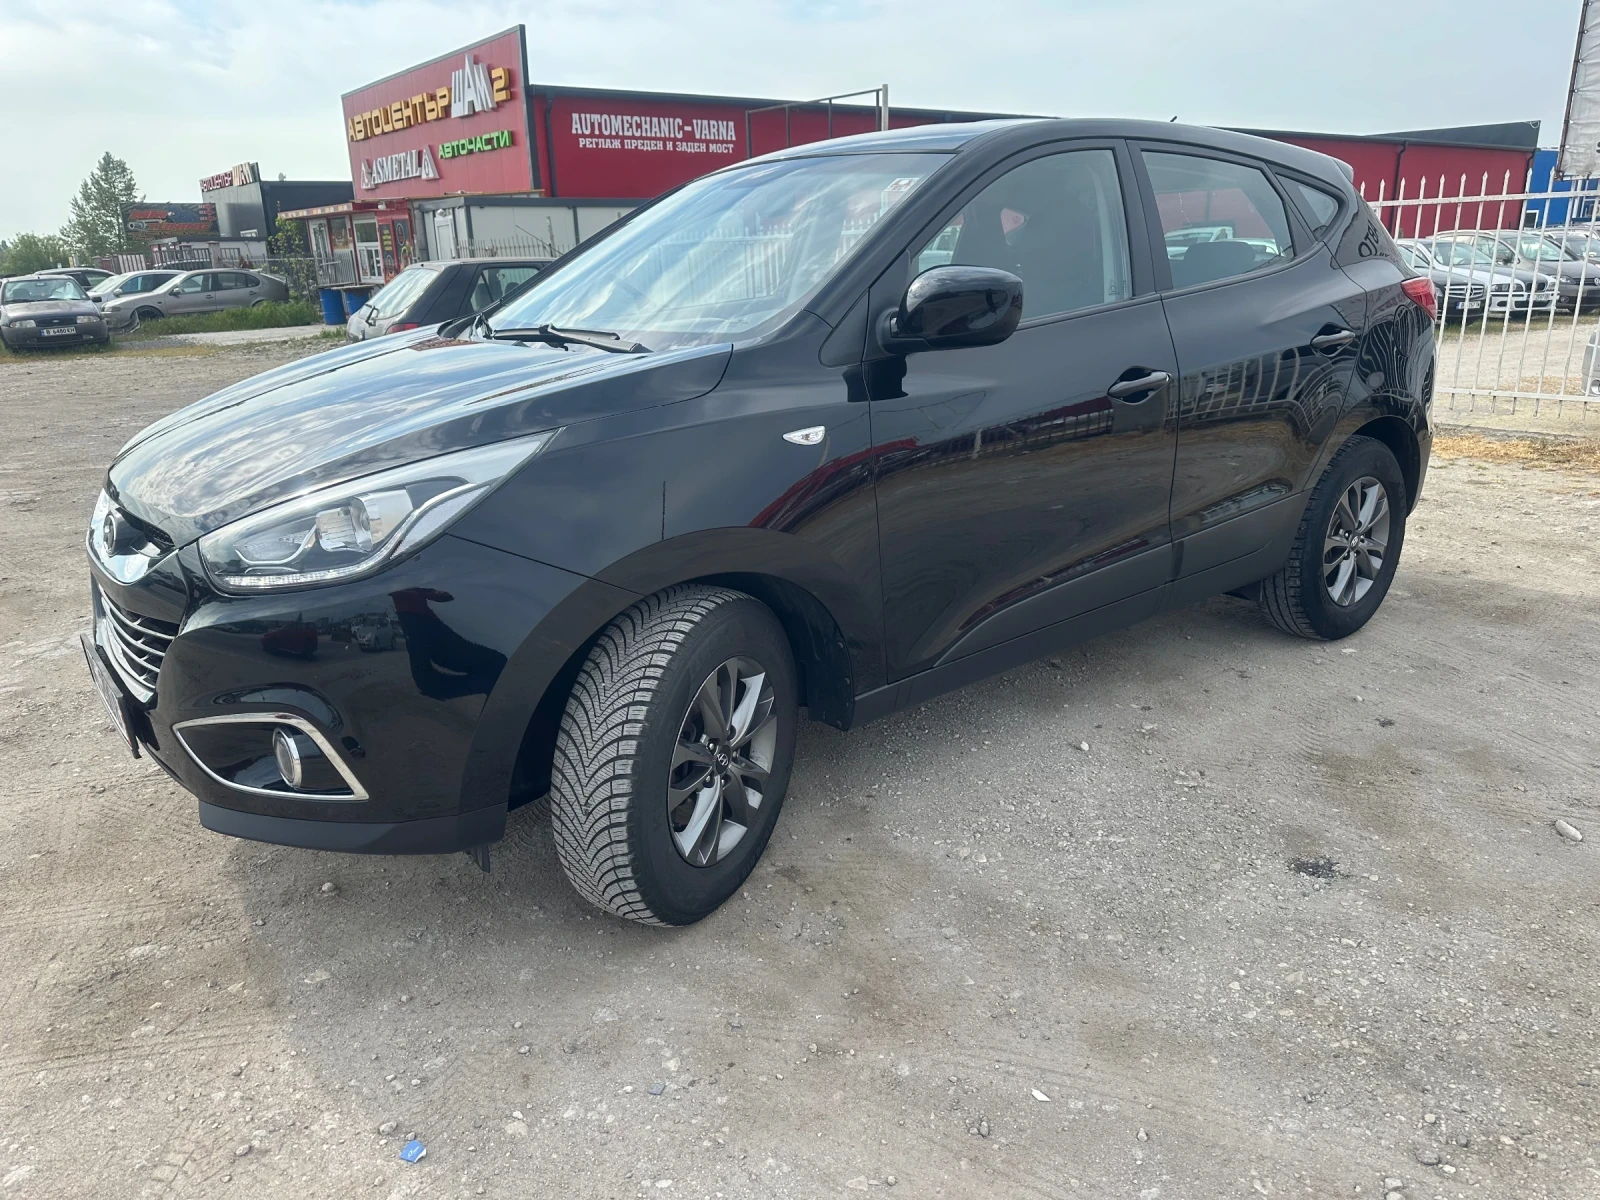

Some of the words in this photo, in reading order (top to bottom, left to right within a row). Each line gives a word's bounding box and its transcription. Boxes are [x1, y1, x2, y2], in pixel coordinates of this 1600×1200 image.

[348, 86, 451, 142] АВТОЦЕНТЪР
[451, 54, 498, 118] ШАМ
[491, 67, 511, 102] 2
[571, 113, 736, 141] AUTOMECHANIC-VARNA
[438, 130, 513, 159] АВТОЧАСТИ
[579, 138, 621, 149] РЕГЛАЖ
[624, 140, 664, 151] ПРЕДЕН
[666, 141, 673, 151] И
[676, 142, 707, 153] ЗАДЕН
[709, 144, 734, 153] МОСТ
[371, 149, 422, 184] ASMETAL
